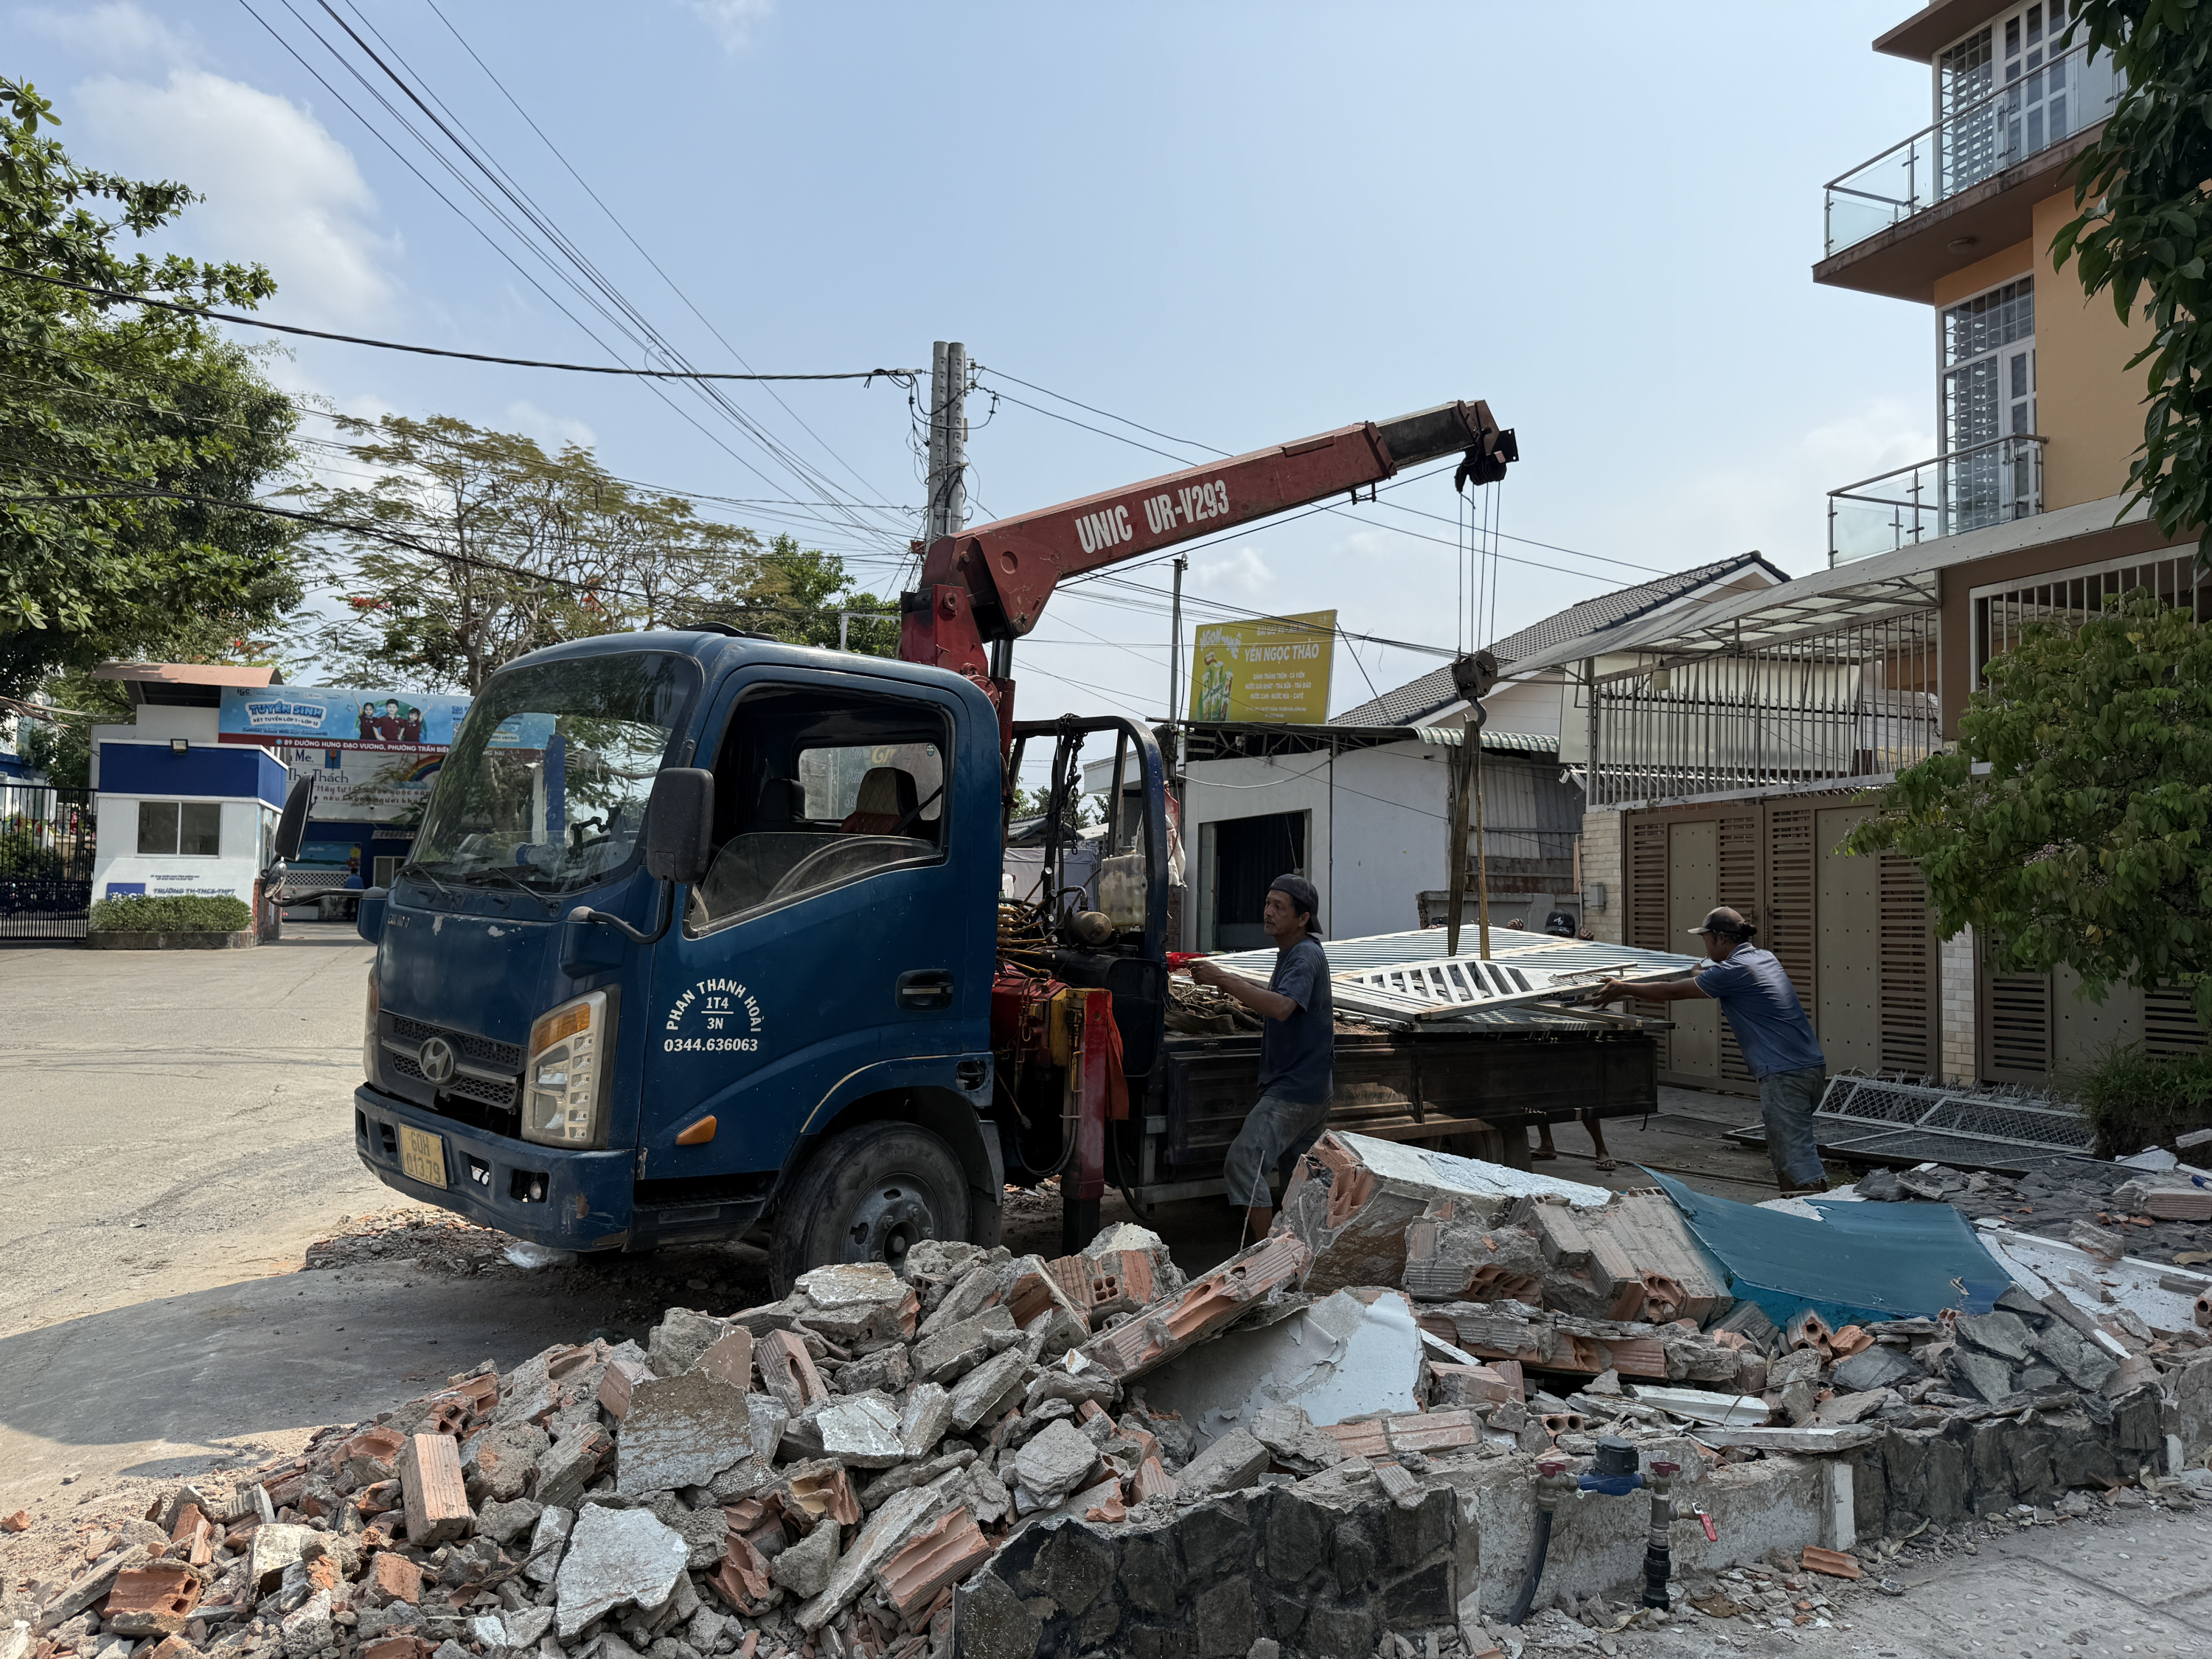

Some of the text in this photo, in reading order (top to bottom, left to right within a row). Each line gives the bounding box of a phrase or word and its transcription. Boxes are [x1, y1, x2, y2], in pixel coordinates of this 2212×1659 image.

[1075, 479, 1230, 554] UNIC UR-V293
[1245, 643, 1262, 662] YẾN
[1264, 646, 1290, 664] NGỌC
[1293, 638, 1319, 659] THẢO
[248, 700, 324, 719] TUYỂN SINH
[343, 742, 358, 750] ĐẠO
[312, 768, 349, 783] Thách
[666, 978, 765, 1032] PHAN THANH HOÀI
[706, 997, 729, 1009] 1T4
[706, 1018, 724, 1029] 3N
[664, 1037, 759, 1052] 0344.636063
[410, 1130, 431, 1158] 60H
[406, 1152, 441, 1183] 013.79
